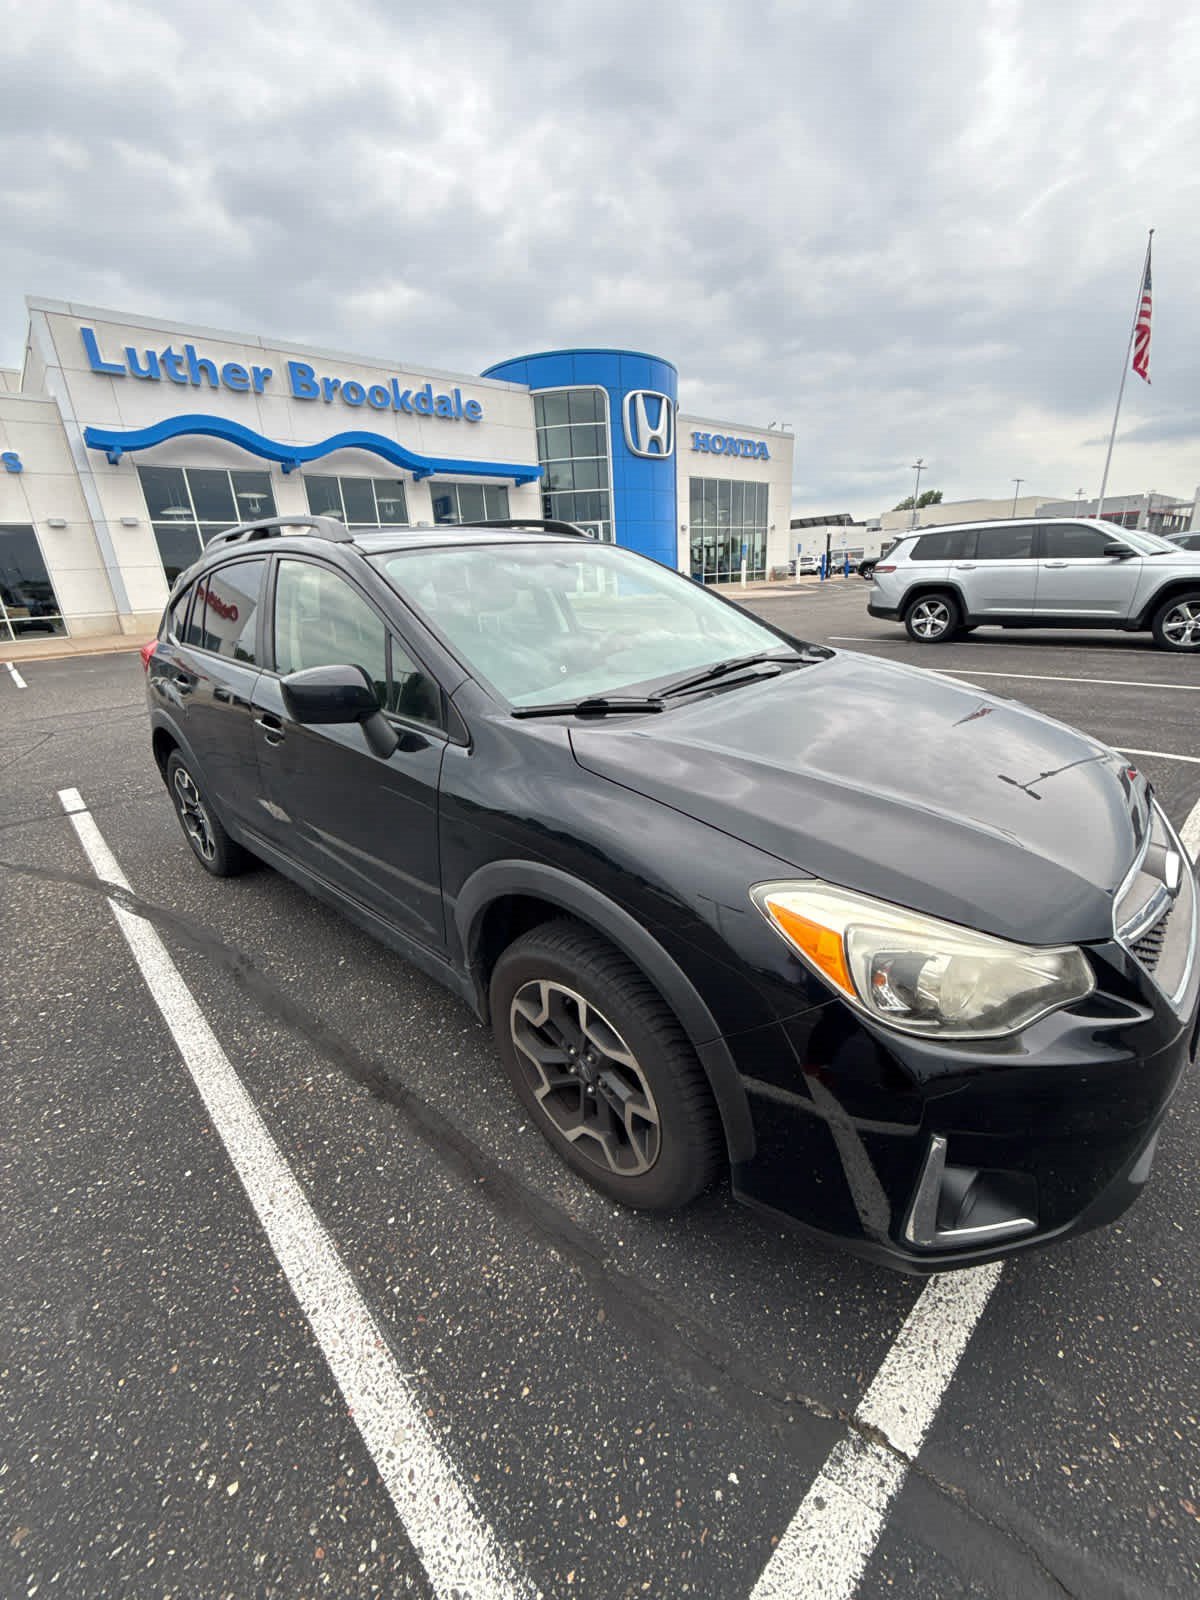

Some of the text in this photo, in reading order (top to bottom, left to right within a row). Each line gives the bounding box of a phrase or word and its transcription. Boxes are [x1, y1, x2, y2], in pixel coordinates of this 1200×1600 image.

[80, 327, 483, 422] Luther Brookdale
[691, 431, 771, 460] HONDA
